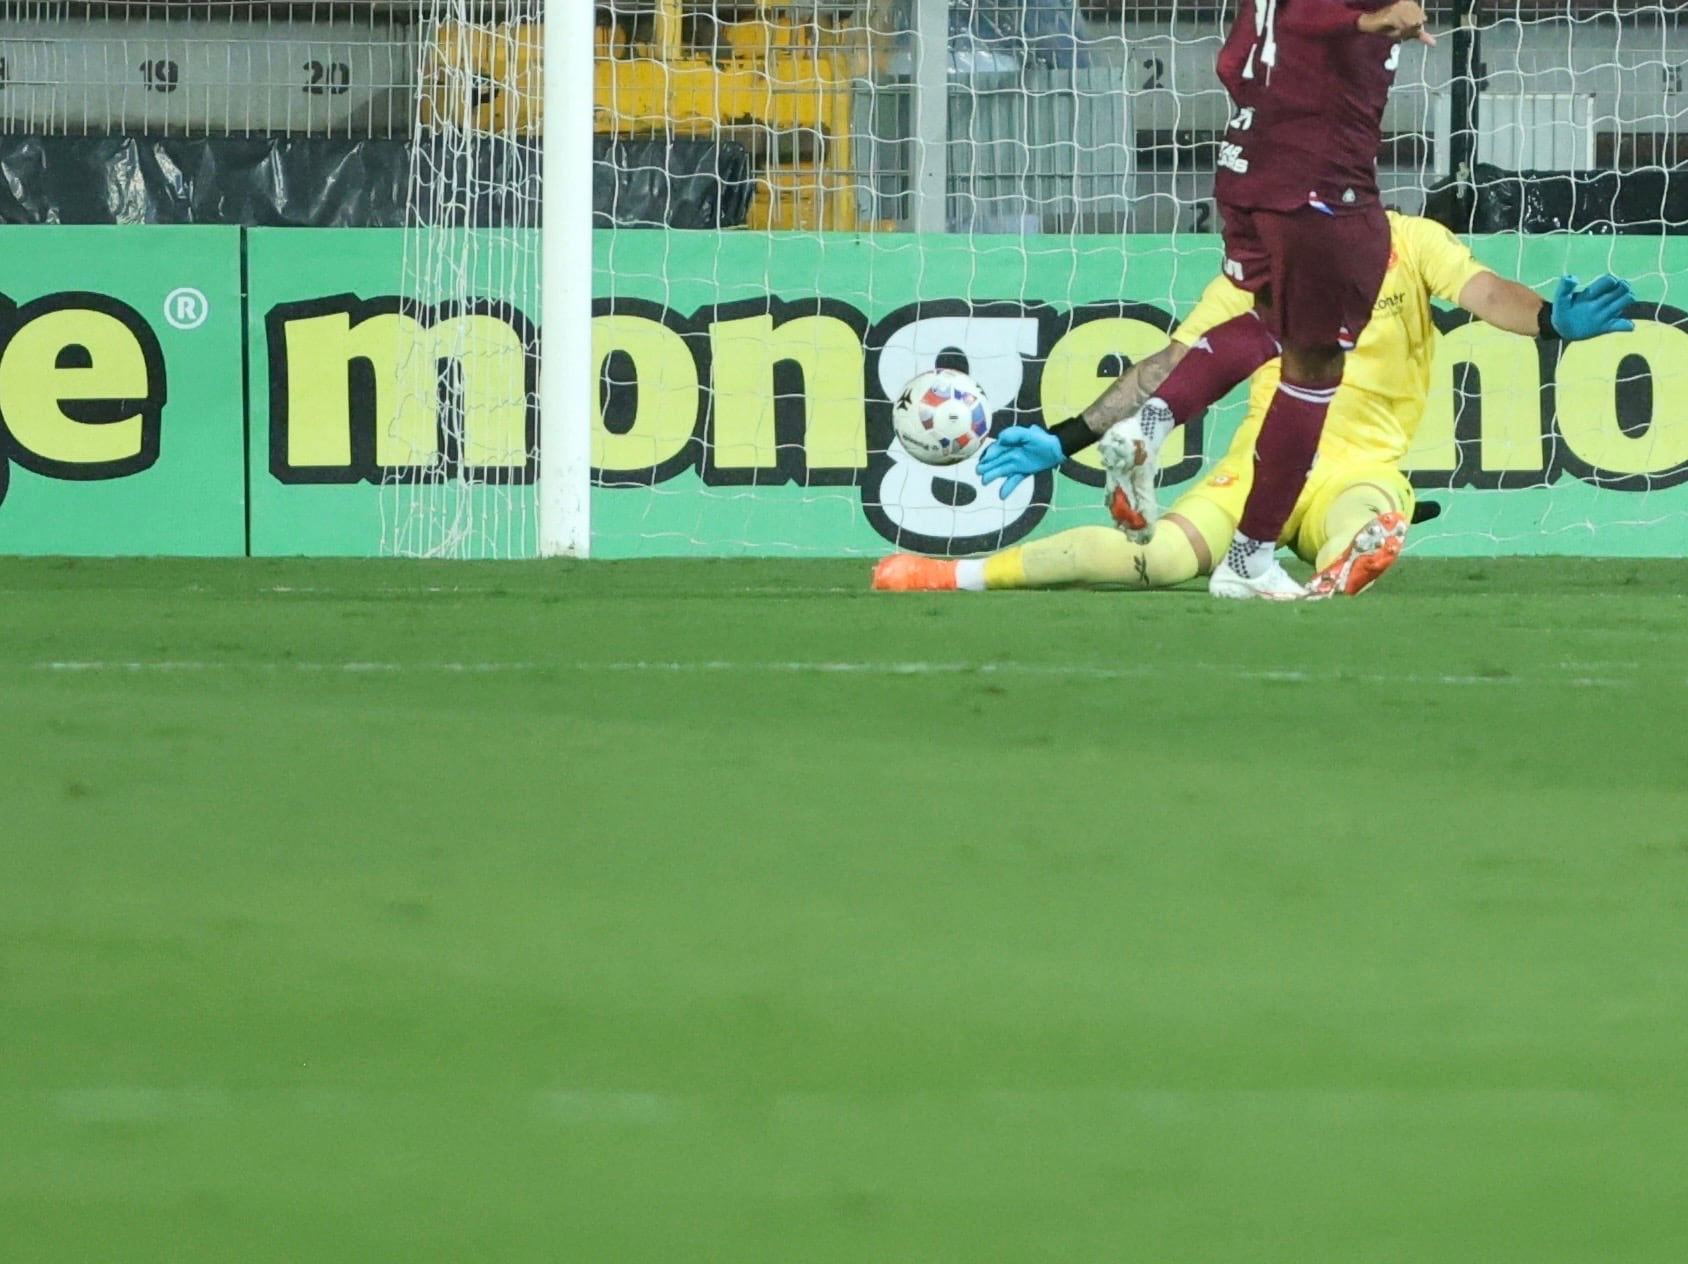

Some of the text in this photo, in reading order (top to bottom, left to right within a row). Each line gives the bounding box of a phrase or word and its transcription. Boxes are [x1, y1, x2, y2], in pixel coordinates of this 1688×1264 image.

[139, 59, 179, 93] 19
[302, 59, 350, 96] 20
[1142, 58, 1165, 89] 2
